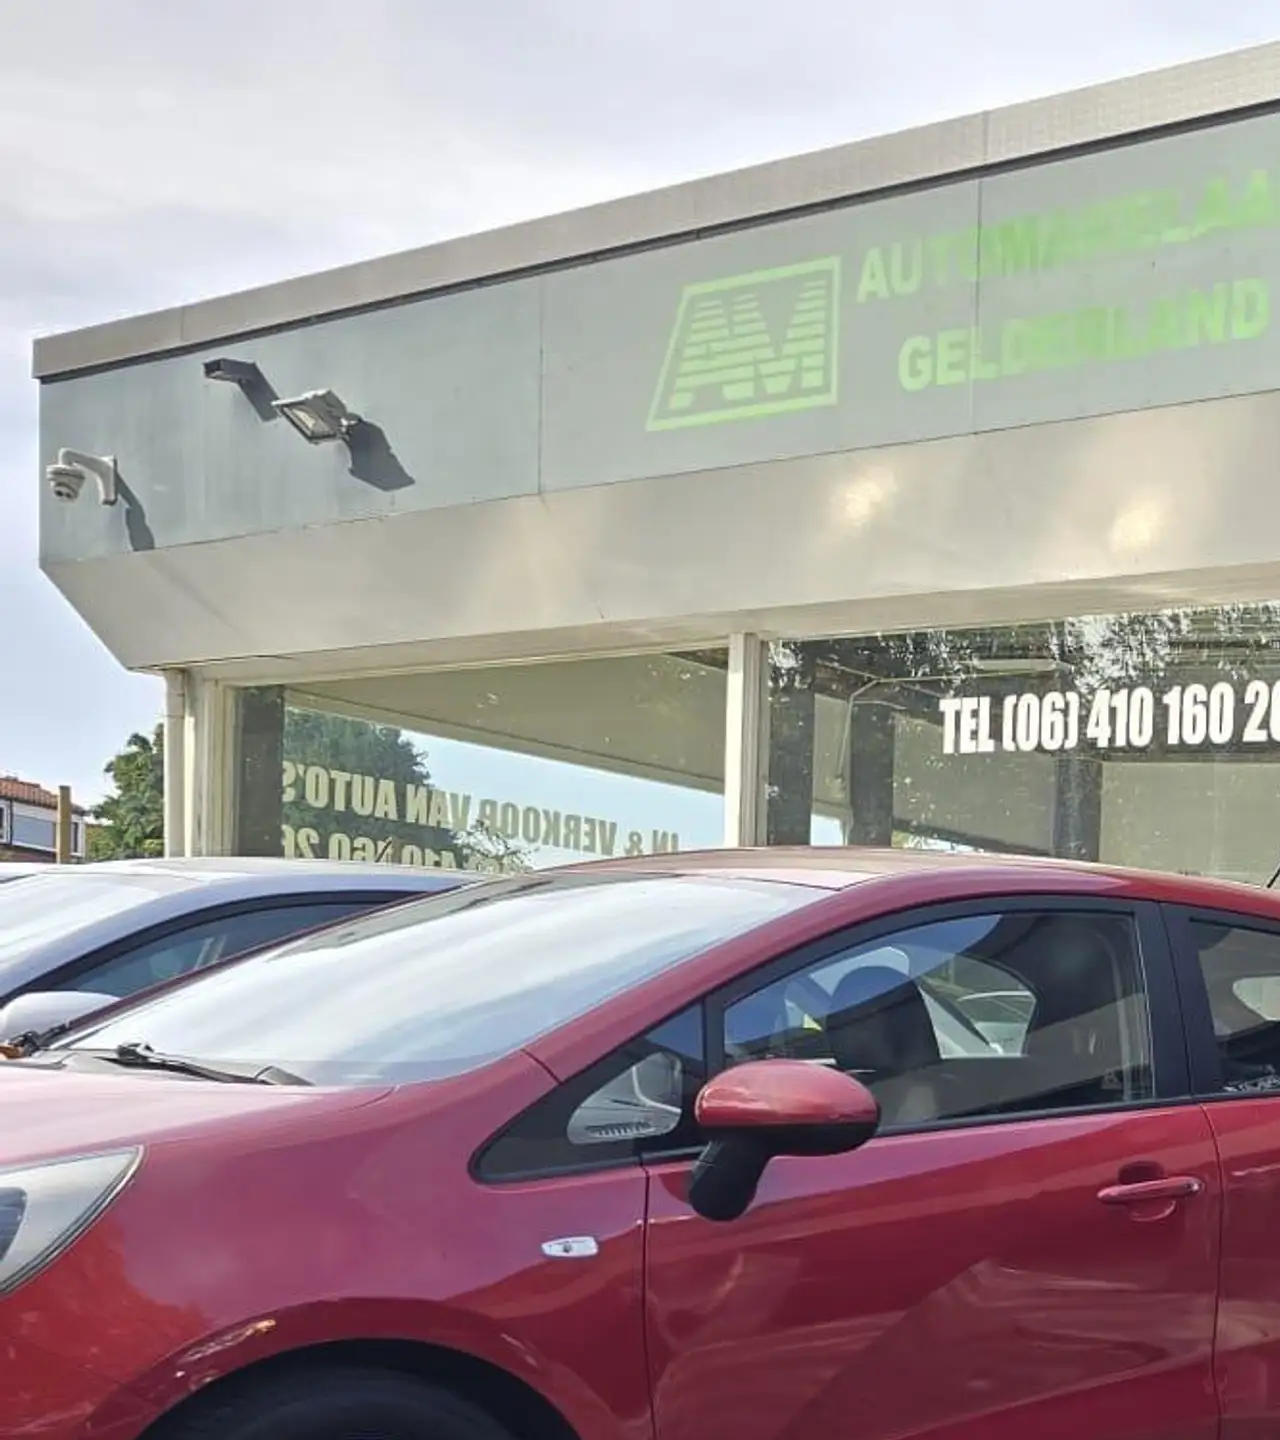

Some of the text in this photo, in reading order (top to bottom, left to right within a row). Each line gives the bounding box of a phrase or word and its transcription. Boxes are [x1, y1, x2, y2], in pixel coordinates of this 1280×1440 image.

[899, 278, 1270, 391] GELDERLAND
[939, 697, 995, 754] TEL
[1002, 692, 1080, 752] (06)
[1086, 687, 1153, 748] 410
[1162, 682, 1235, 746] 160
